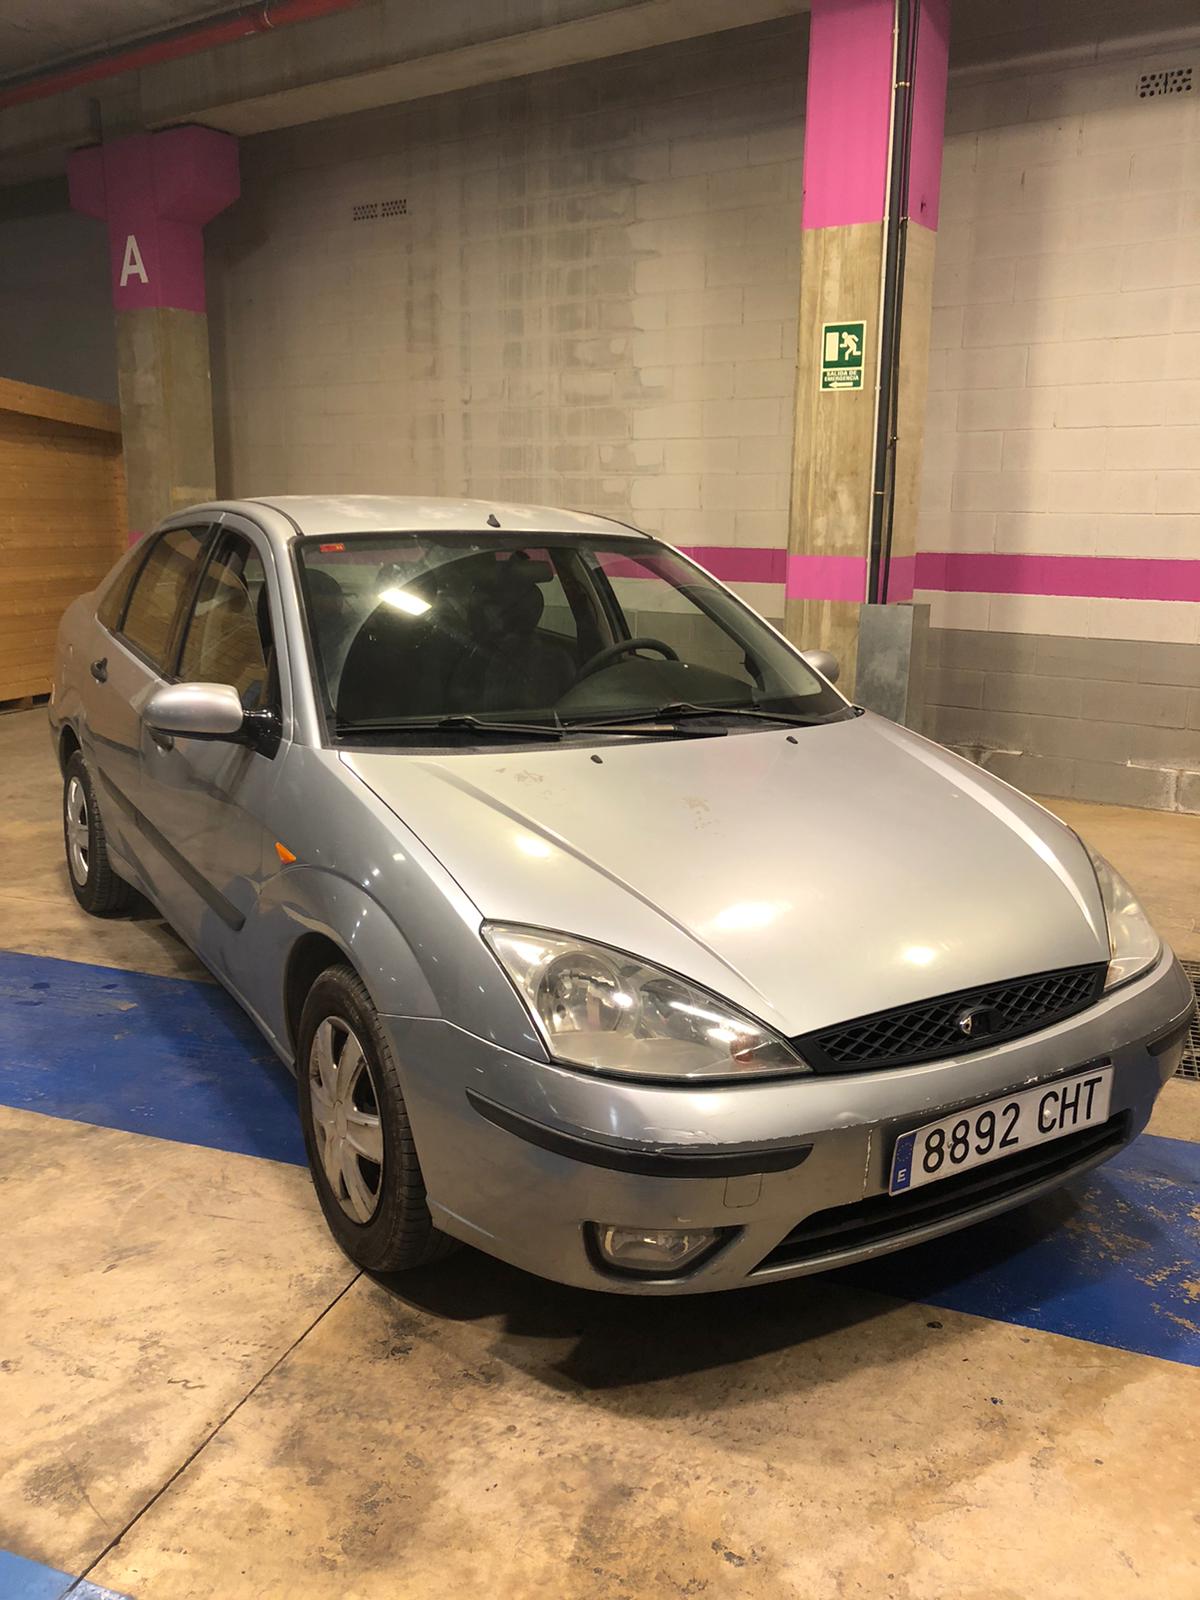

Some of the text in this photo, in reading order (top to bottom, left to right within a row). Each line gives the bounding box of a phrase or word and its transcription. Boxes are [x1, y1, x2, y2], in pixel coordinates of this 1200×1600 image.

[120, 234, 148, 287] A
[922, 1076, 1102, 1173] 8892 CHT
[897, 1168, 907, 1183] E
